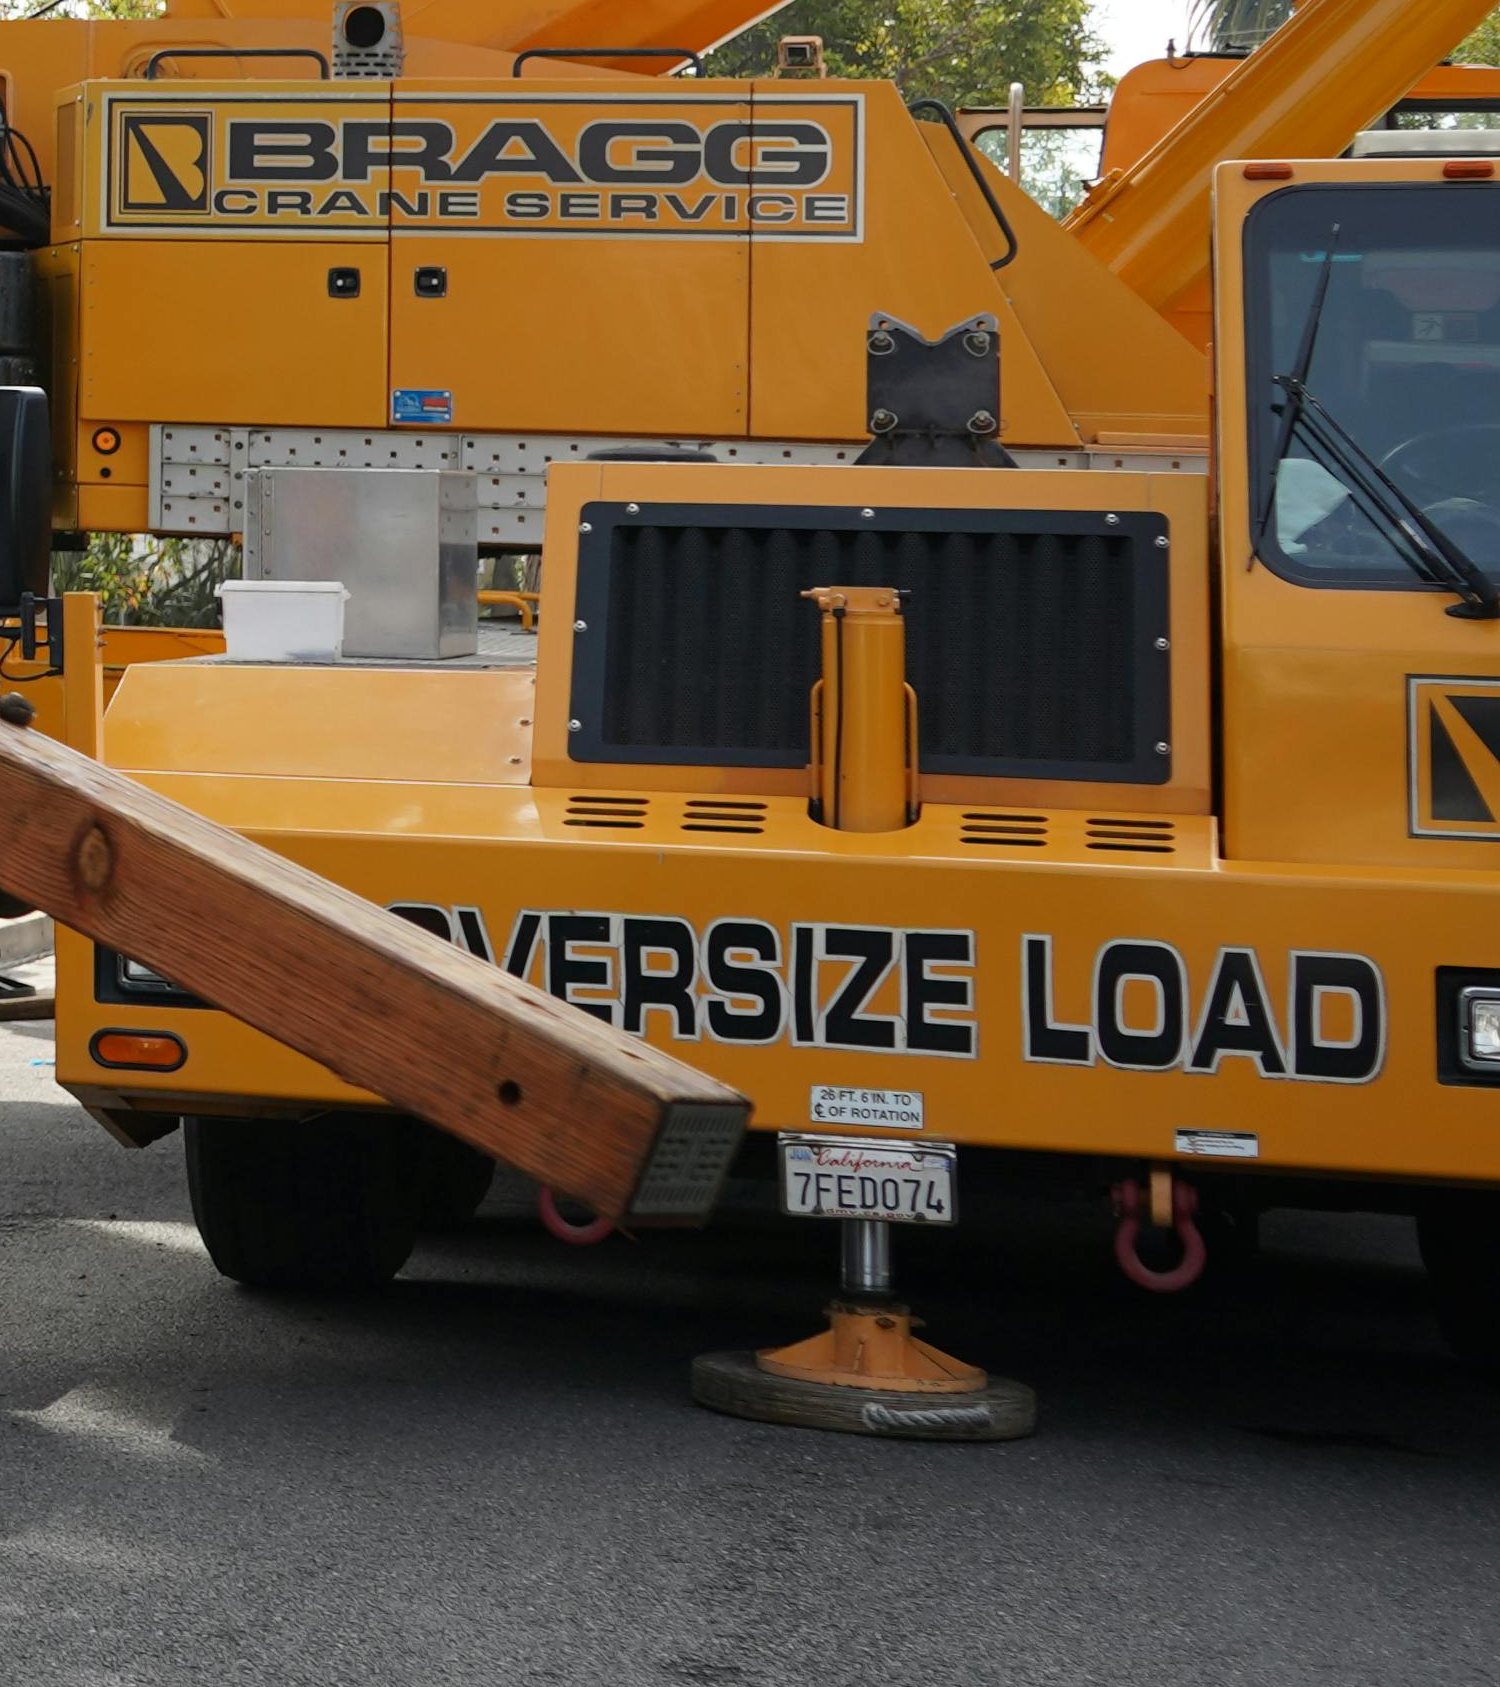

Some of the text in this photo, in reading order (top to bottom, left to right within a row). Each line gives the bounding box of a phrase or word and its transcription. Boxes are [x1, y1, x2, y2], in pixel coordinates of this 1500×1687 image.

[227, 119, 830, 187] BRAGG
[213, 189, 849, 224] CRANE SERVICE
[1022, 933, 1388, 1082] LOAD
[820, 1089, 911, 1106] 26 FT. 6 IN. TO
[829, 1106, 920, 1122] OF ROTATION
[789, 1149, 922, 1172] JUN California
[794, 1172, 945, 1214] 7FED074
